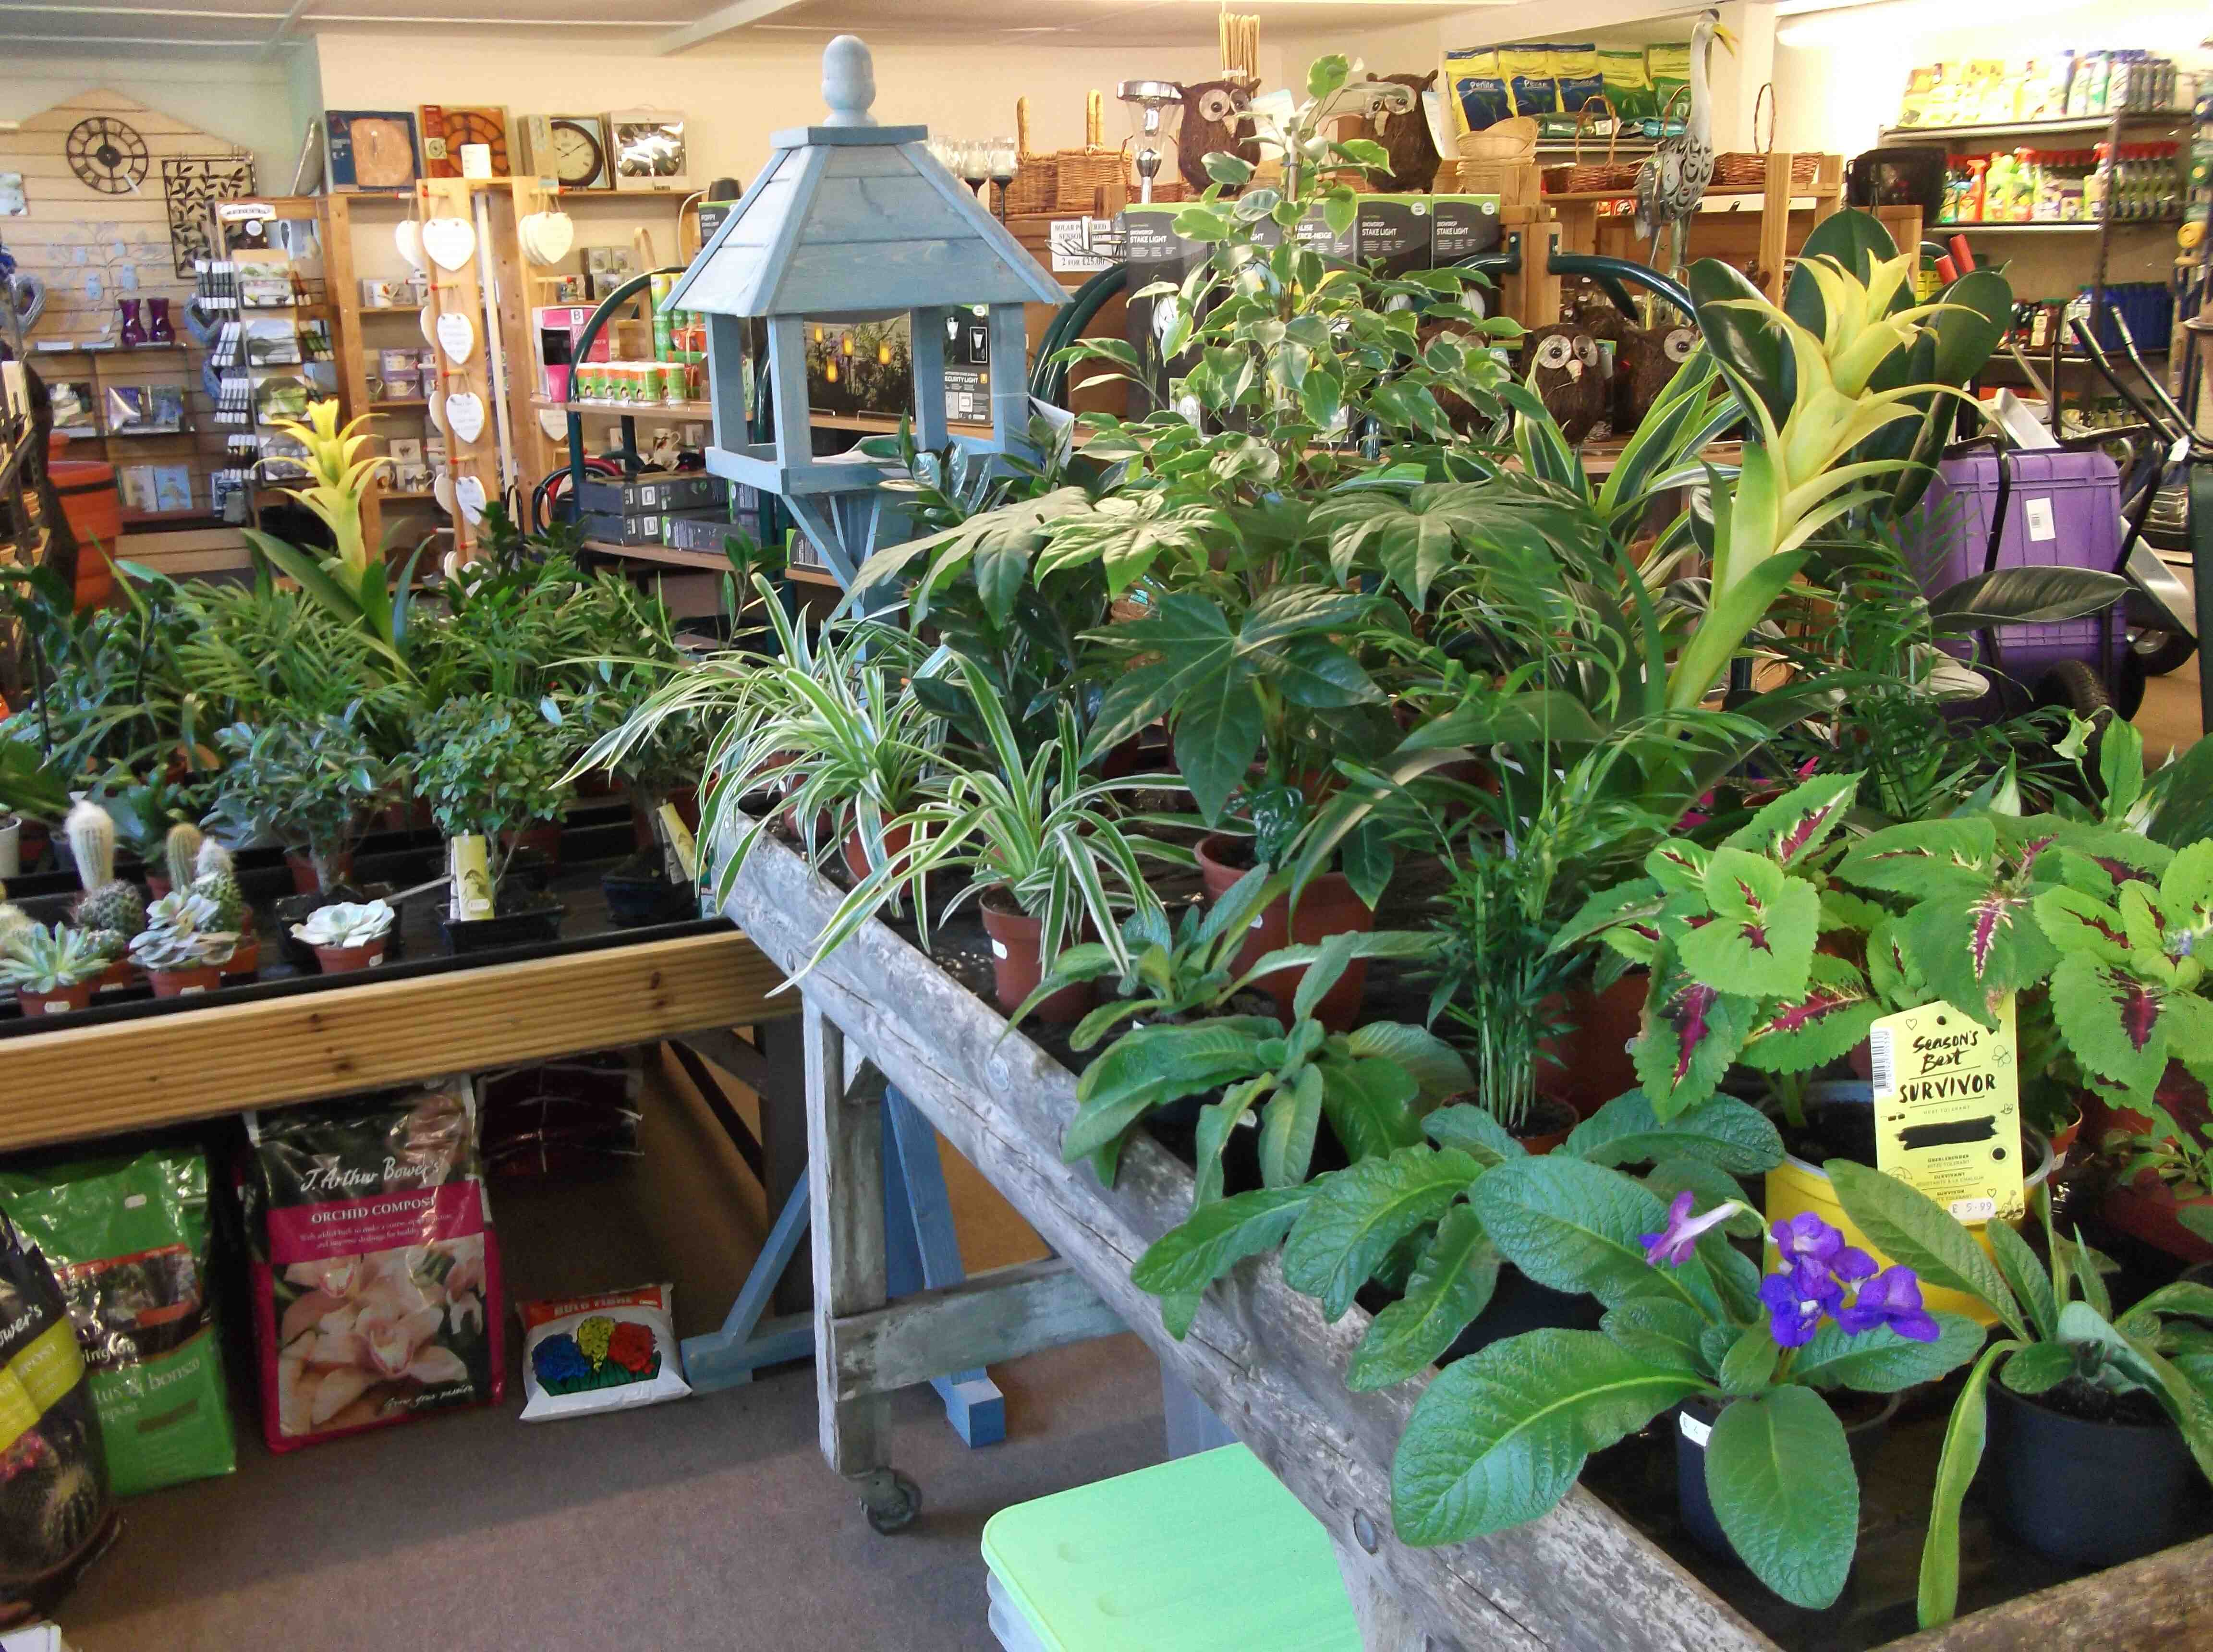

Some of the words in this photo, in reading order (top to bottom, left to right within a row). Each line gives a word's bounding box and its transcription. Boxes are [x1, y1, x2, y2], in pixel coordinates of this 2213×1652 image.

[1062, 257, 1065, 266] 2
[574, 311, 580, 319] B
[1920, 1047, 1970, 1075] Best
[1899, 1074, 1997, 1103] SURVIVOR
[301, 1168, 316, 1191] J.
[321, 1166, 379, 1189] Arthur
[312, 1206, 369, 1224] ORCHID
[371, 1196, 436, 1215] COMPOST
[1967, 1201, 1992, 1213] 5.99
